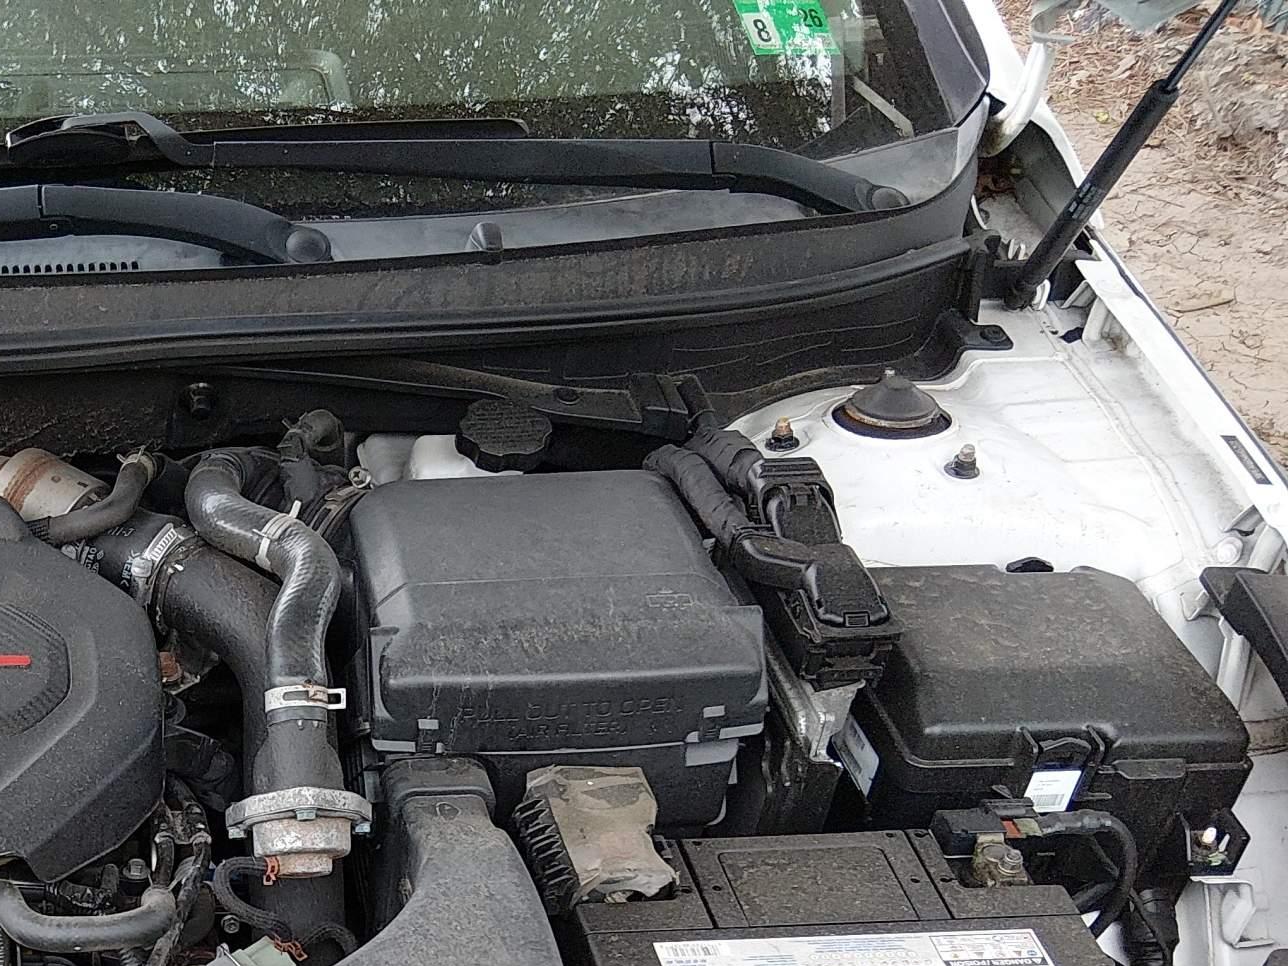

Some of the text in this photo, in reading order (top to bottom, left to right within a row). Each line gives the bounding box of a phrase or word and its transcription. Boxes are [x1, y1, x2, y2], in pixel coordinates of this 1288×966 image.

[752, 18, 773, 43] 8
[798, 9, 824, 28] 26
[461, 698, 683, 722] PULL OUT TO OPEN
